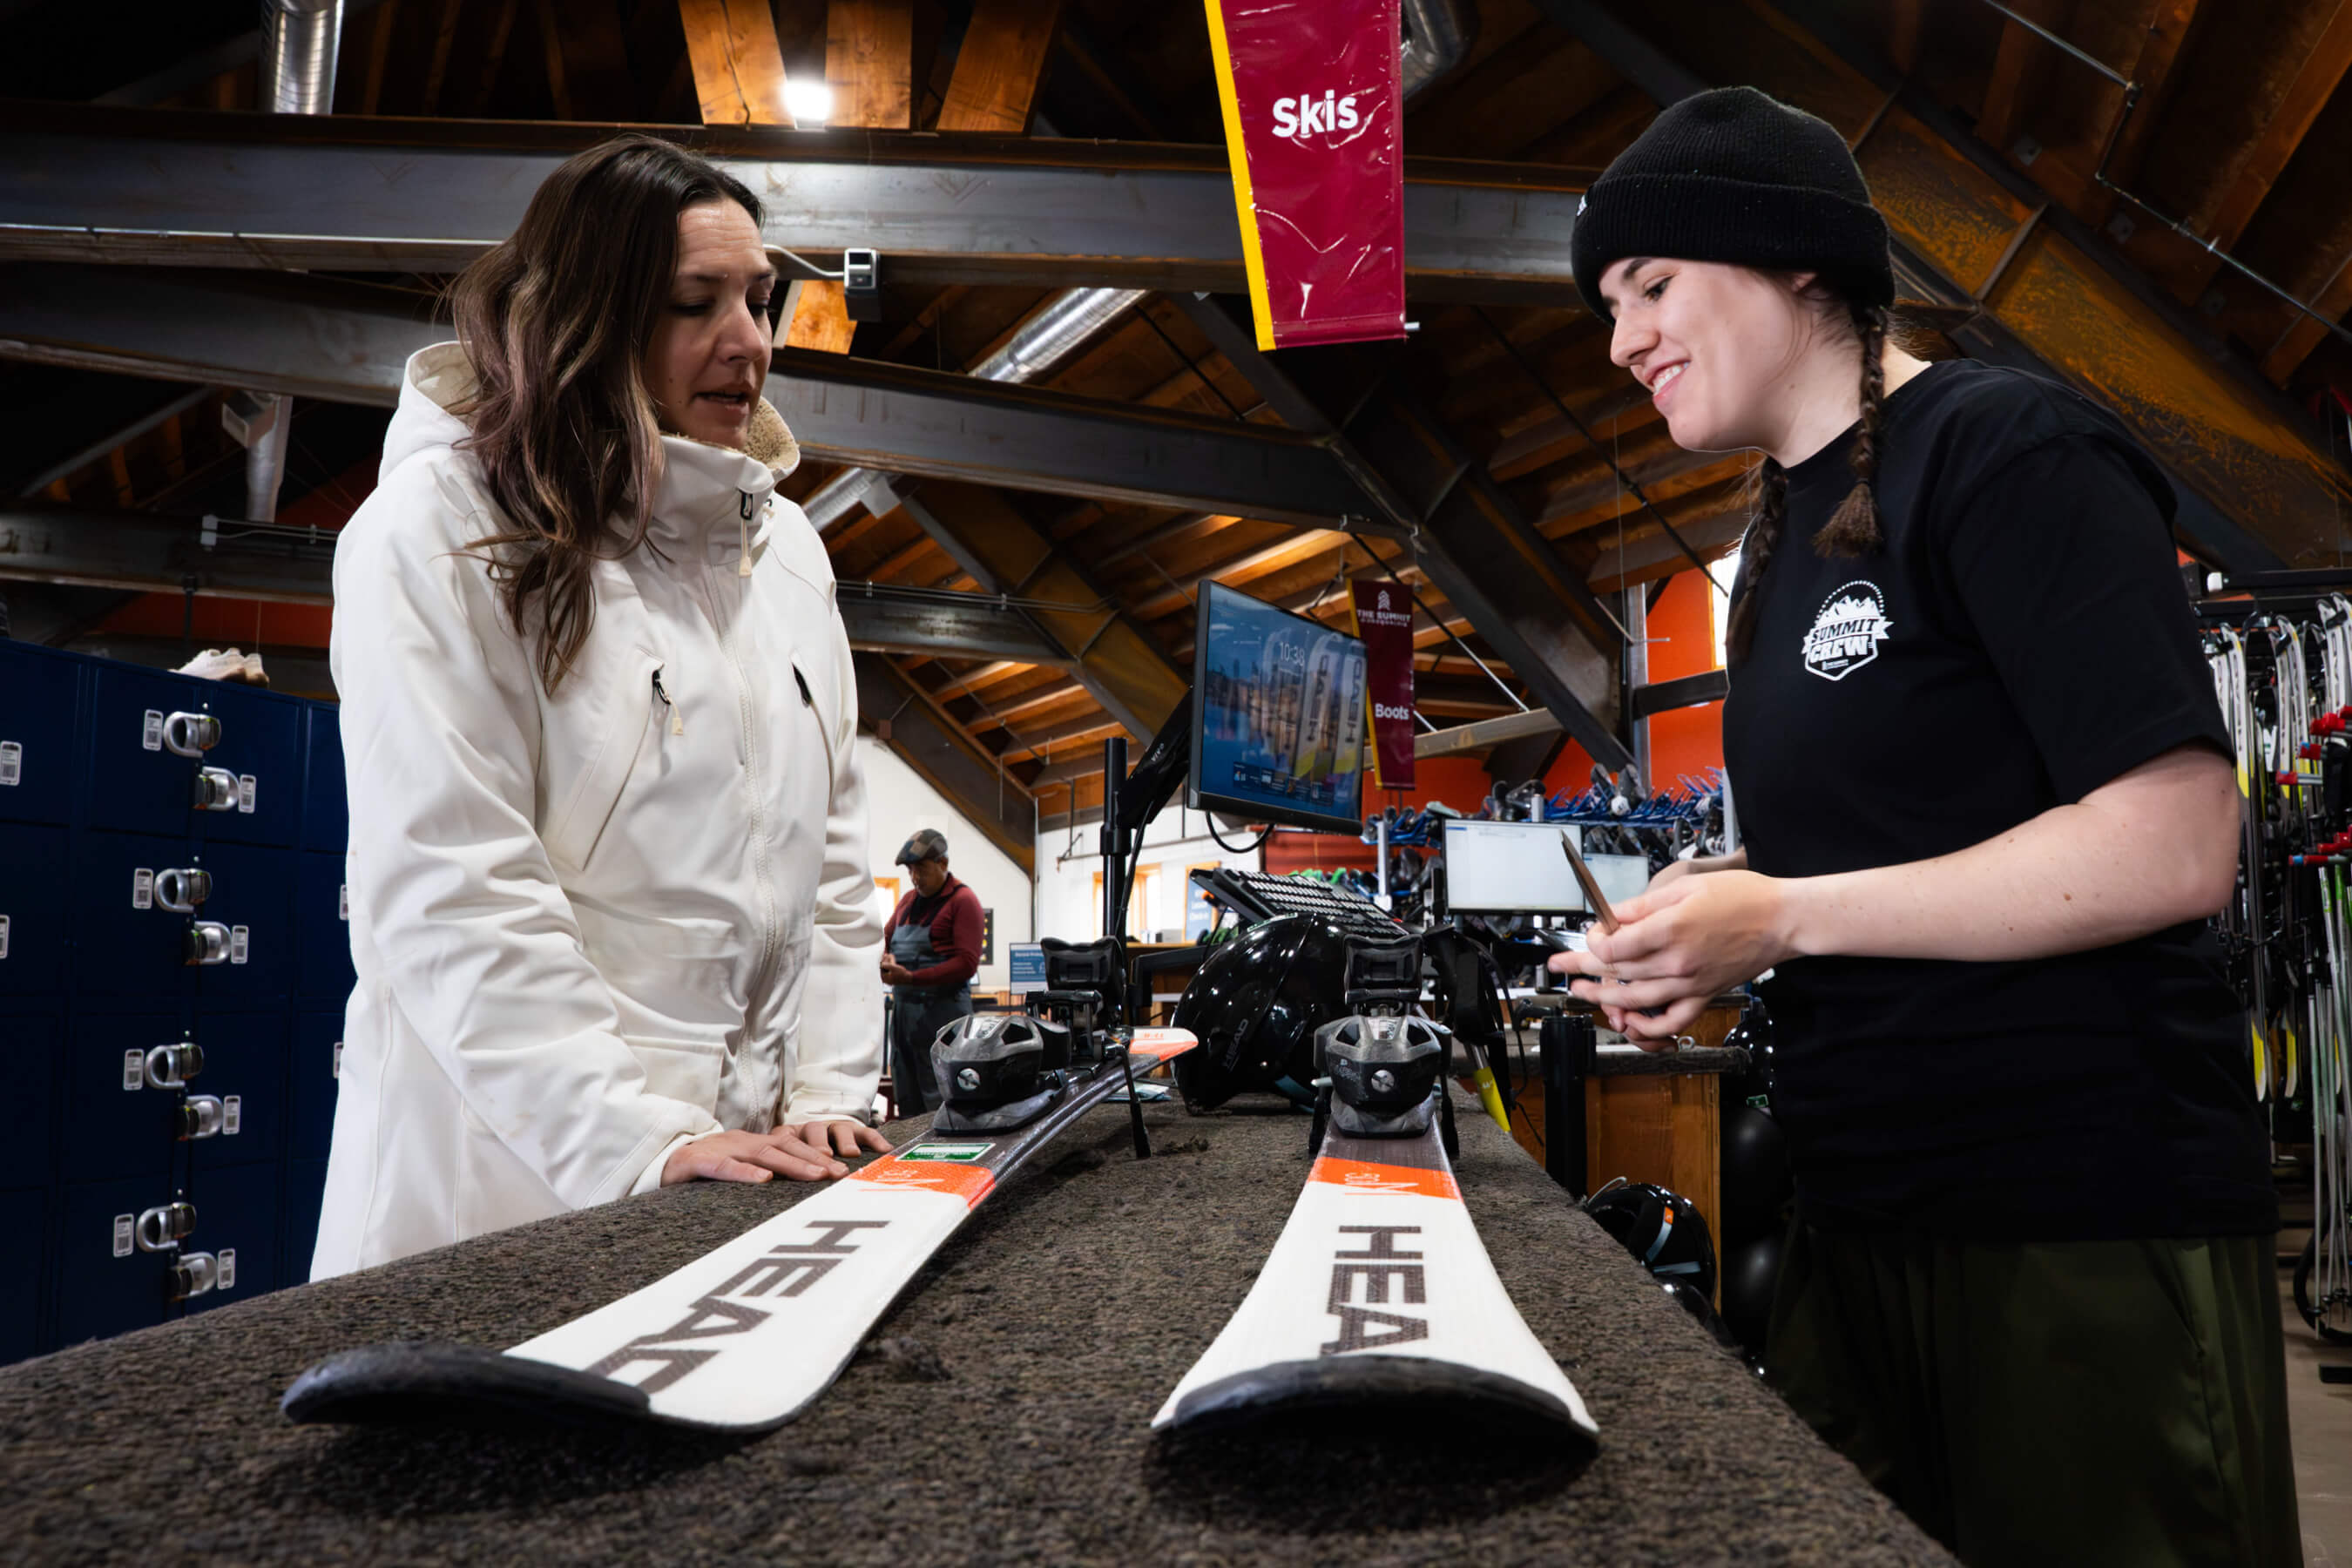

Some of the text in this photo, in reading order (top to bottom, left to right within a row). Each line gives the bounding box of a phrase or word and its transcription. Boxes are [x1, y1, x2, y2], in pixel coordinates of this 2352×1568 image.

[1272, 90, 1358, 138] Skis
[1357, 609, 1410, 622] THE SUMMIT
[1812, 618, 1879, 644] SUMMIT
[1809, 635, 1869, 664] CREW
[1375, 703, 1409, 720] Boots
